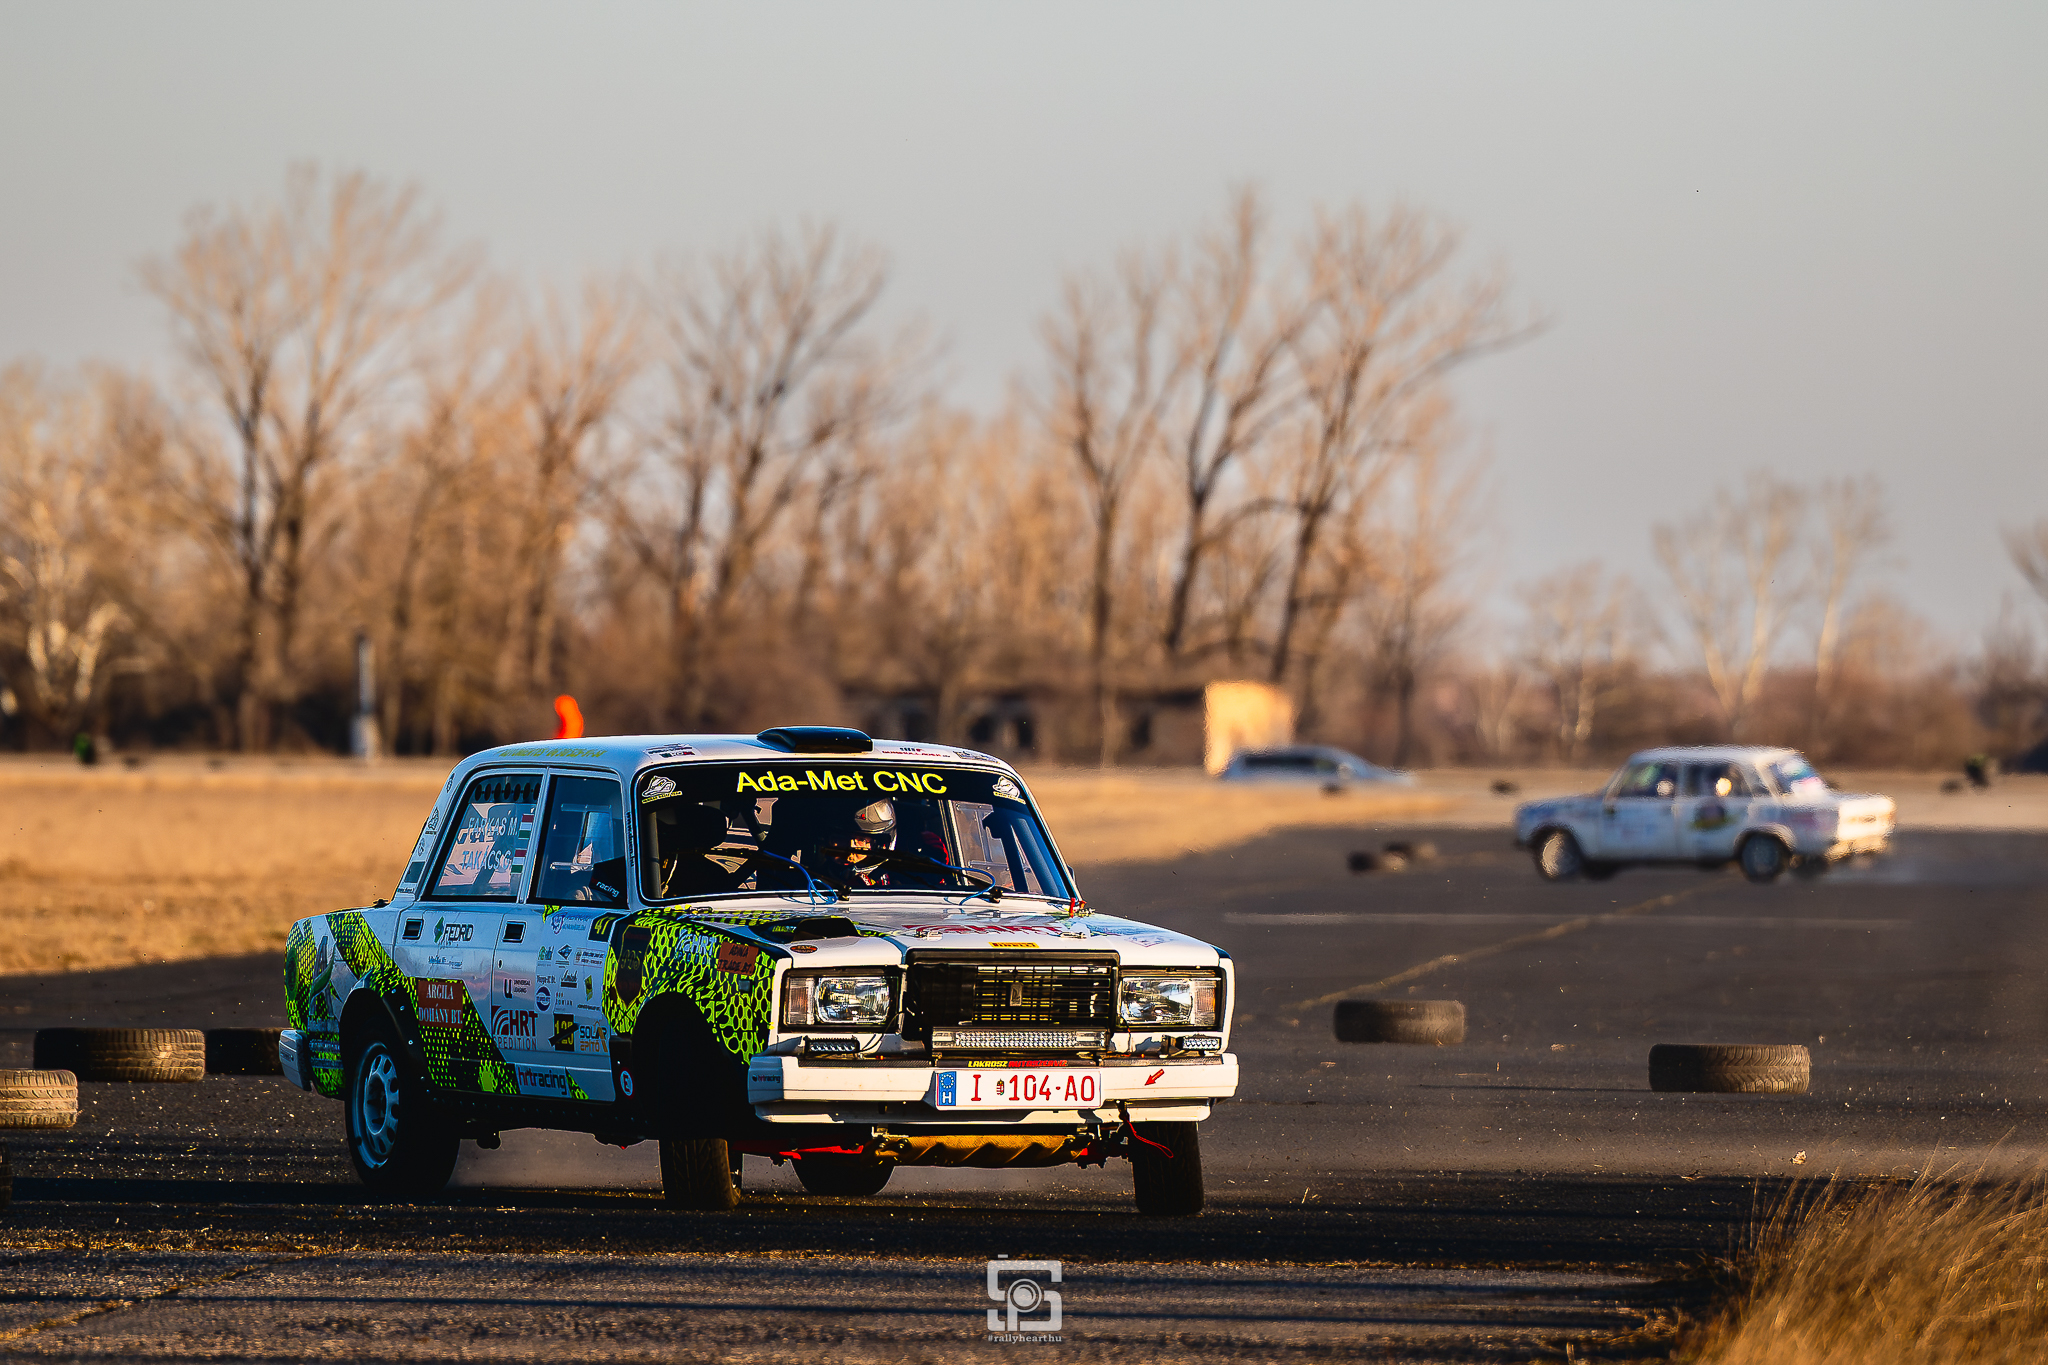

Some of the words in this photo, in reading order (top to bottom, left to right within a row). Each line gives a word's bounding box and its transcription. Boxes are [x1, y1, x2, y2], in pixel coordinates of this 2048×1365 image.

[736, 770, 869, 793] Ada-Met
[873, 770, 948, 795] CNC
[468, 816, 507, 836] FARKAS
[461, 844, 500, 870] TAKÁCS
[594, 915, 617, 935] 47
[425, 983, 454, 1000] ARGILA
[418, 1003, 450, 1023] DOHÁNY
[451, 1009, 463, 1024] BT.
[509, 1009, 538, 1037] HRT
[967, 1060, 1008, 1068] LAKROSZ
[517, 1066, 568, 1096] hrtracing
[942, 1091, 953, 1104] H
